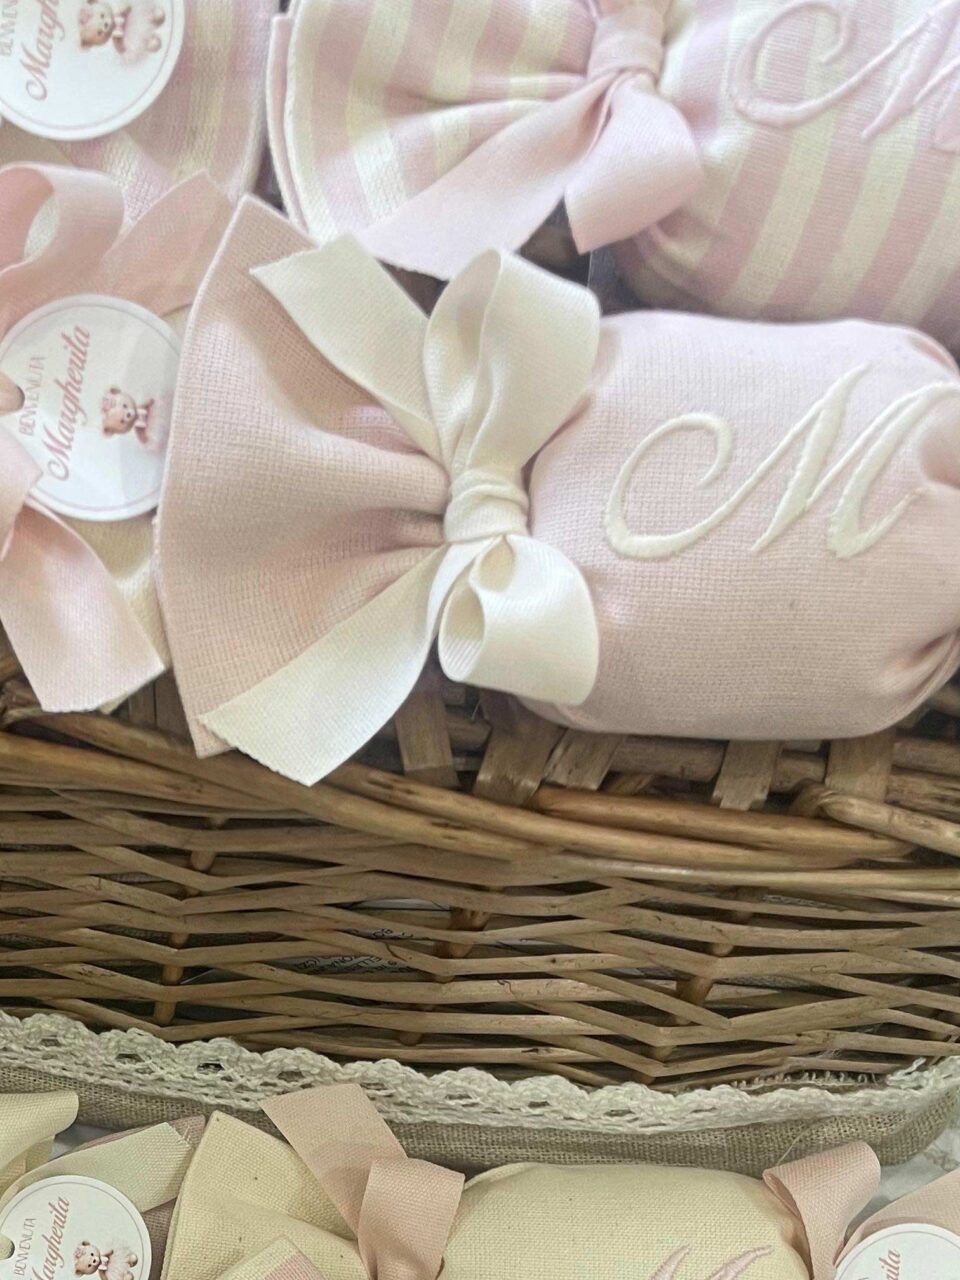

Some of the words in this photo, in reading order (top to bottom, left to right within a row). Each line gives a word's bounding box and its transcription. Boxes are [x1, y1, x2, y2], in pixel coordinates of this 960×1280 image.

[41, 324, 91, 482] Margherita
[603, 362, 960, 560] M
[13, 1217, 36, 1277] BENVENUTA
